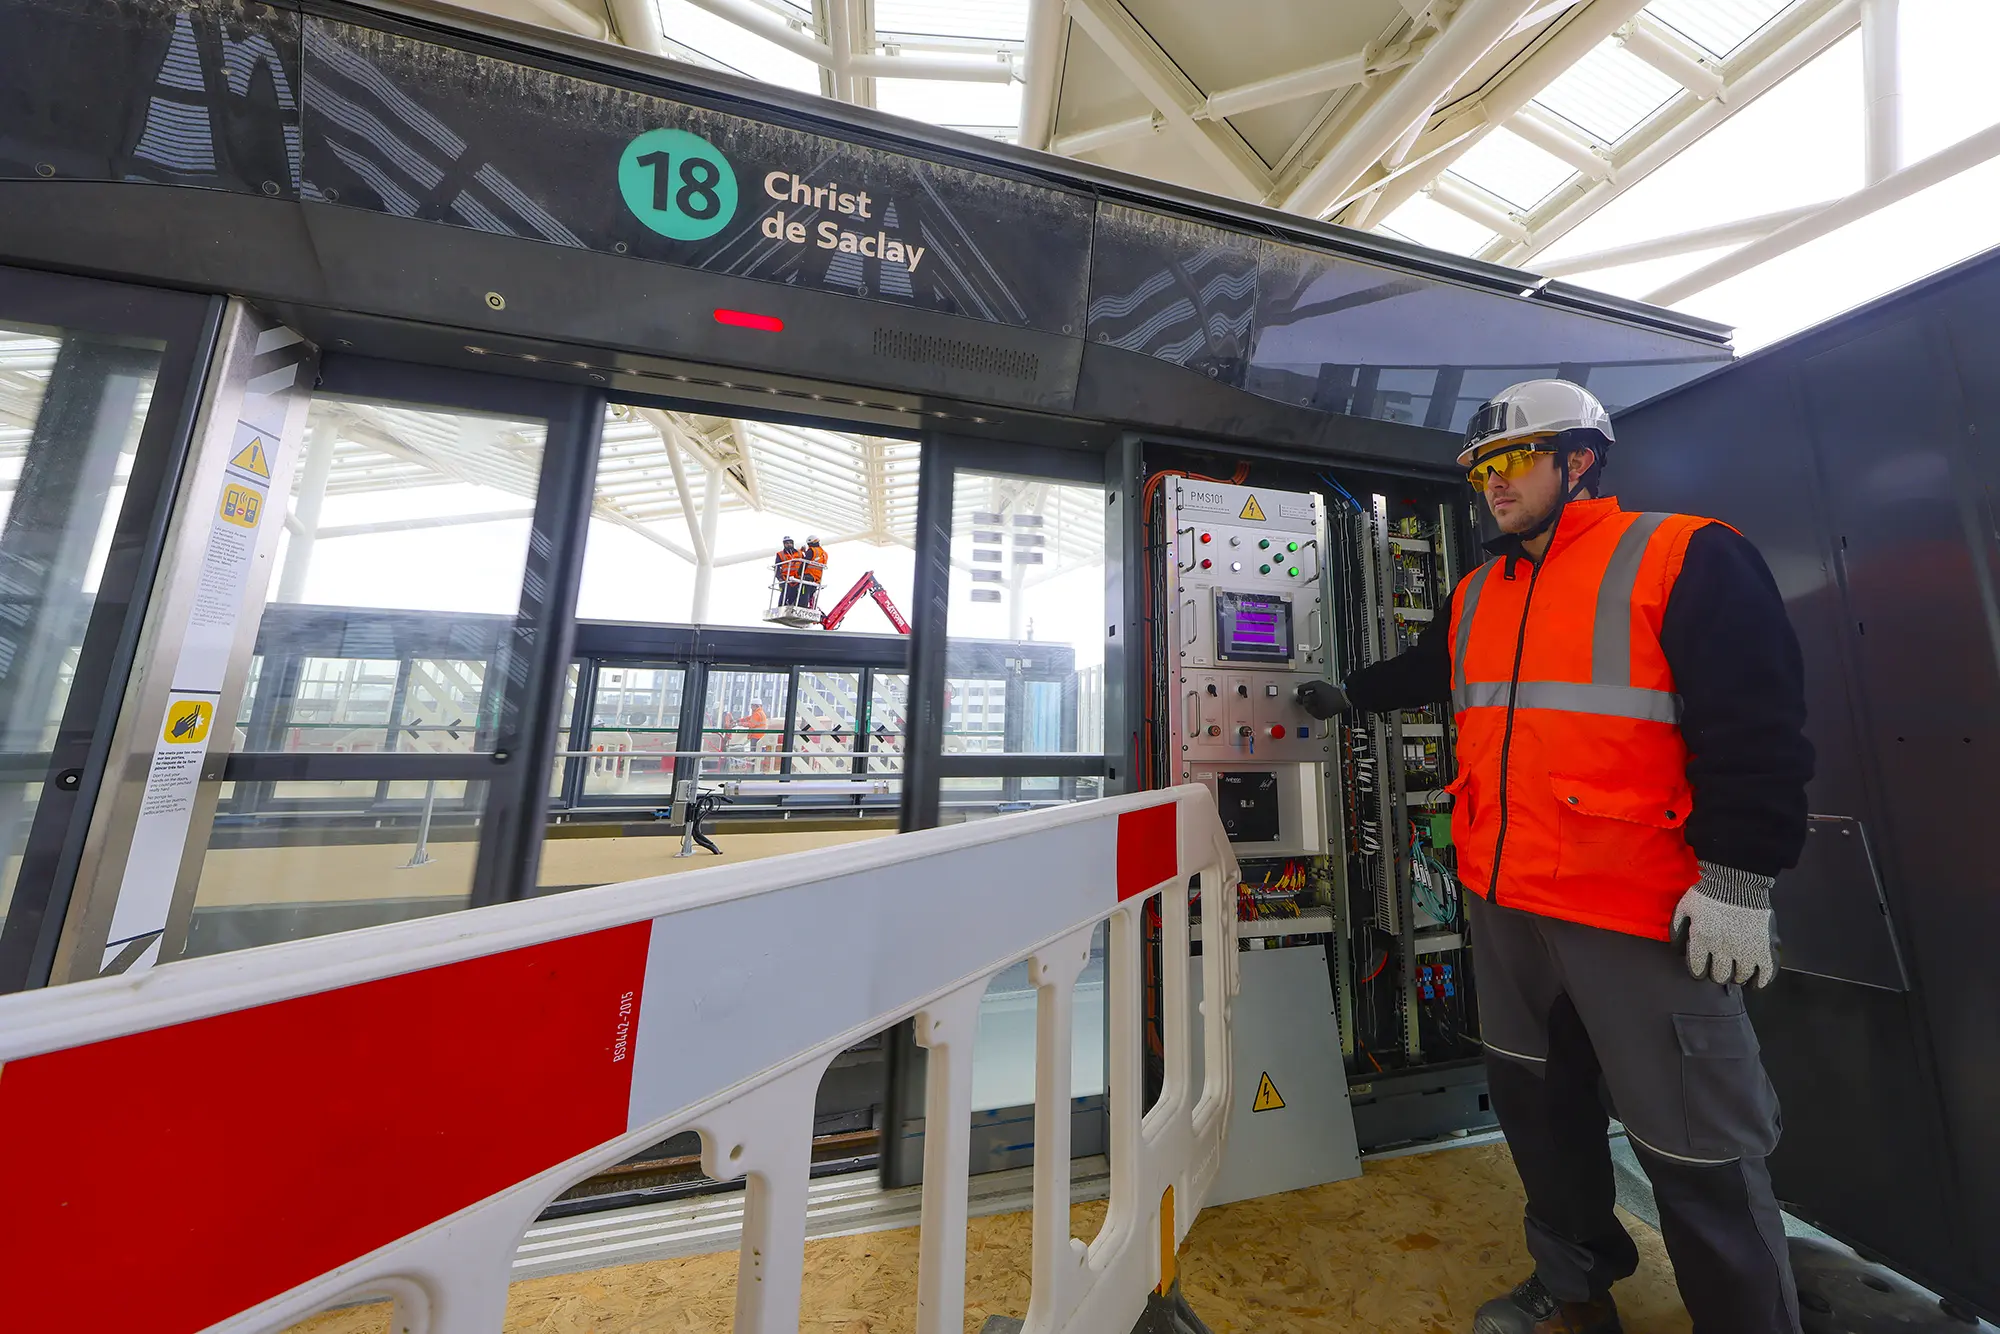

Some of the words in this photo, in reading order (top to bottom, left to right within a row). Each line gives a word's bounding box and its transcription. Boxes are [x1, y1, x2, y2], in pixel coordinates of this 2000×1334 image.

[636, 150, 720, 221] 18
[763, 171, 872, 219] Christ
[761, 211, 806, 244] de
[816, 220, 925, 273] Saclay
[1190, 491, 1223, 504] PMS101
[612, 991, 633, 1063] BS8442-2015
